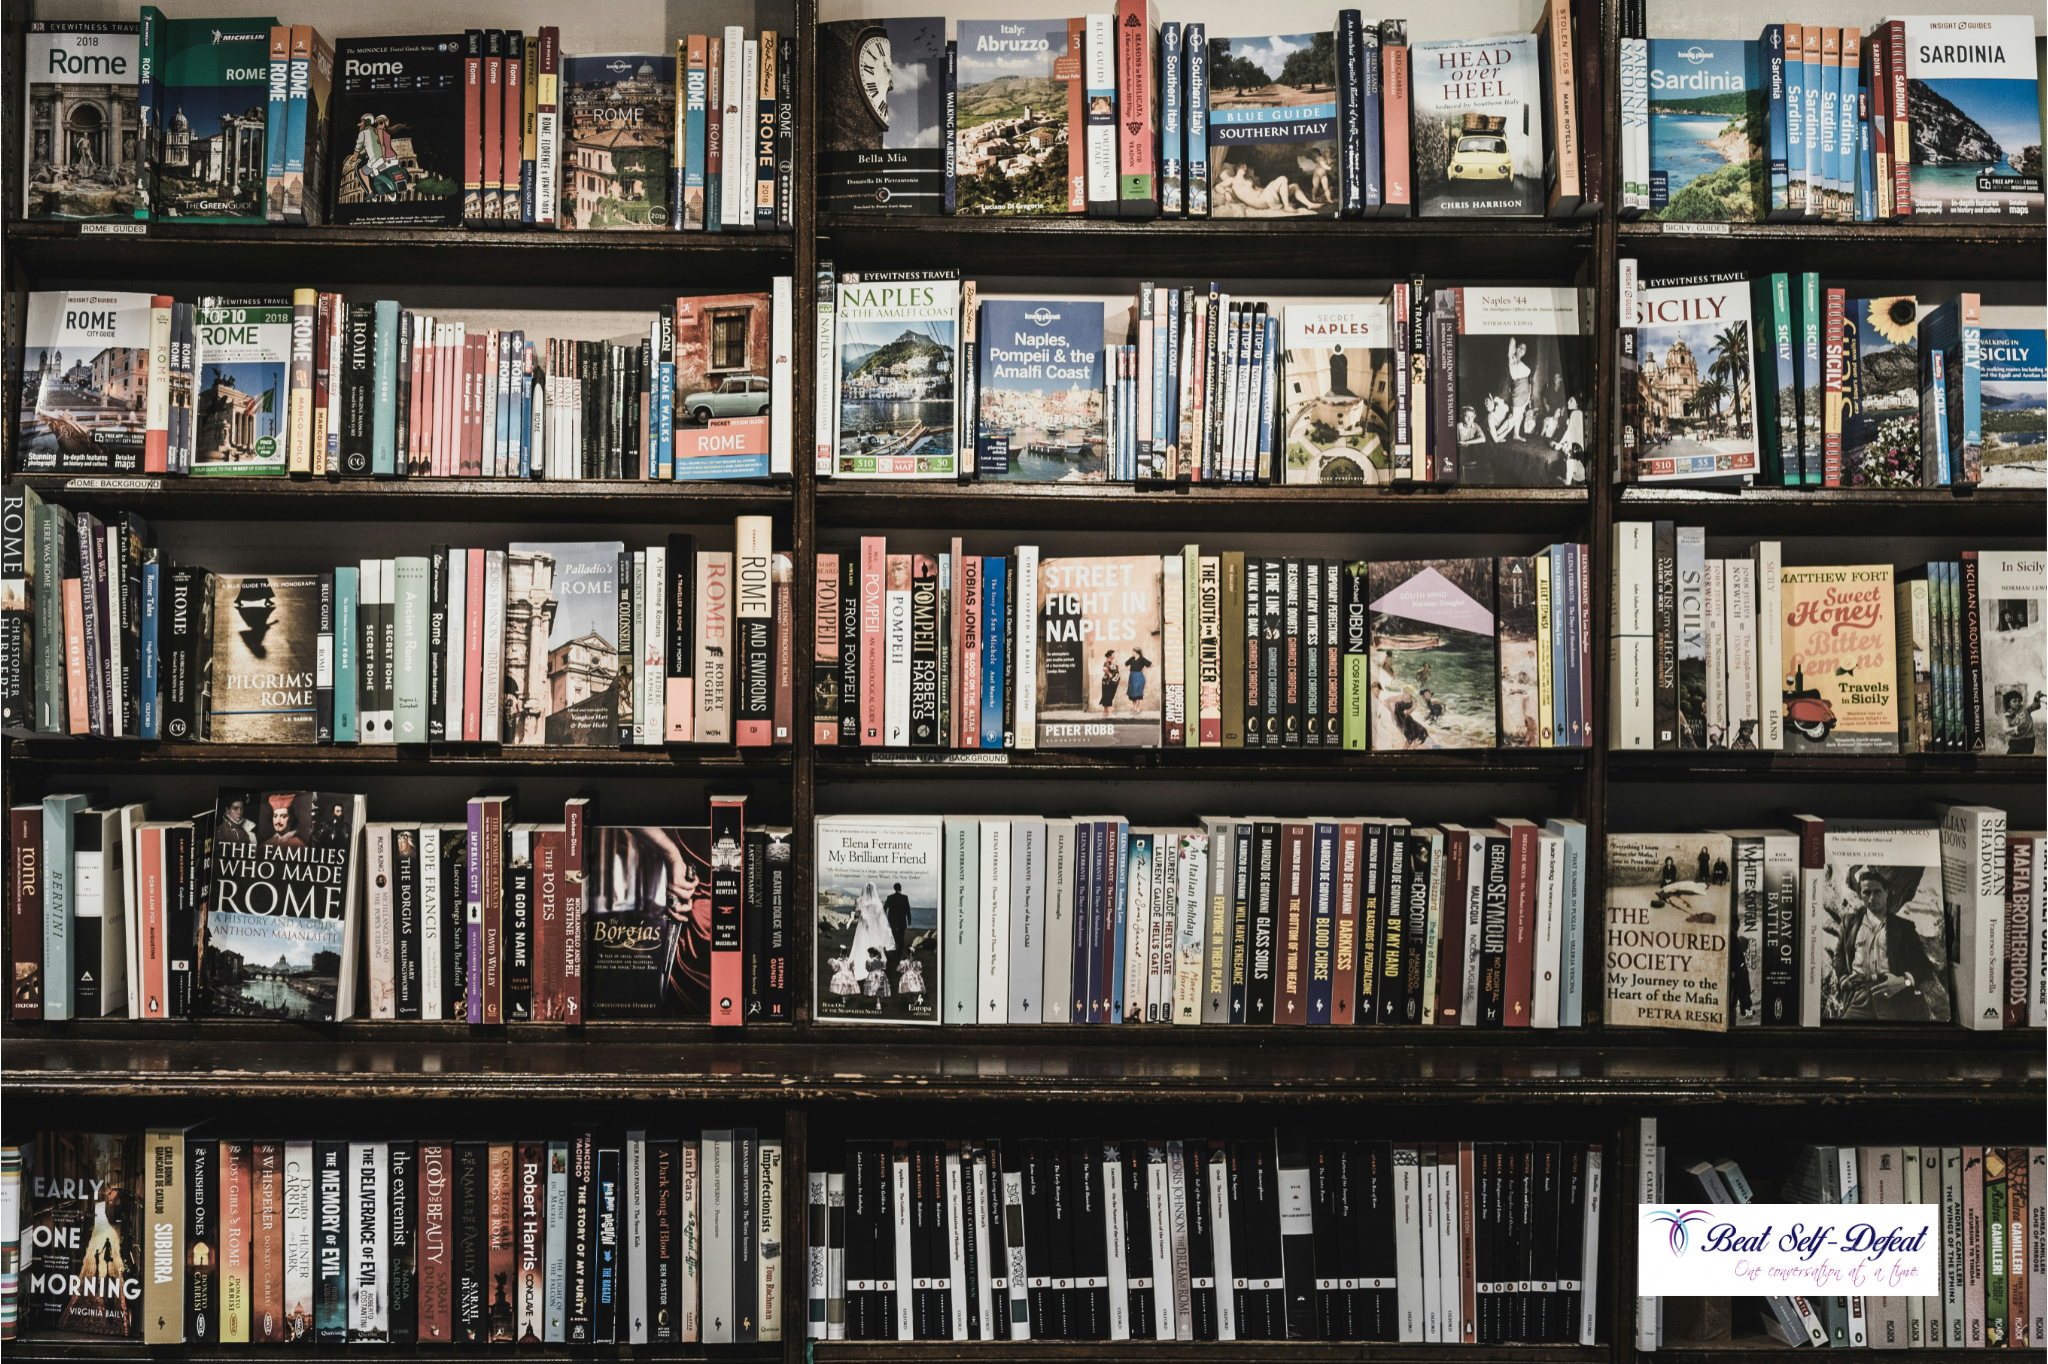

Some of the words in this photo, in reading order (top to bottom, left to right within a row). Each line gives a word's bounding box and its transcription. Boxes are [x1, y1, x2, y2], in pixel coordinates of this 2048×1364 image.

[50, 23, 108, 32] EYEWITNESS
[222, 32, 266, 41] MICHELIN
[1000, 25, 1025, 35] Italy:
[1930, 22, 1956, 30] INSIGHT
[76, 36, 99, 47] 2018
[977, 36, 1049, 52] Abruzzo
[49, 49, 127, 74] Rome
[1438, 49, 1512, 69] HEAD
[1919, 46, 2006, 64] SARDINIA
[142, 57, 150, 84] ROME
[226, 68, 266, 81] ROME
[345, 60, 403, 76] Rome
[1166, 55, 1177, 96] Southern
[1451, 67, 1501, 81] over
[1650, 69, 1744, 90] Sardinia
[270, 63, 287, 102] ROME
[1443, 82, 1511, 100] HEEL
[593, 108, 644, 122] ROME
[946, 92, 954, 129] WALKING
[1167, 100, 1176, 133] Italy
[1227, 112, 1264, 121] BLUE
[1272, 108, 1321, 119] GUIDE
[760, 113, 773, 167] ROME
[946, 131, 954, 139] IN
[1220, 127, 1289, 138] SOUTHERN
[1293, 123, 1327, 135] ITALY
[858, 154, 882, 163] Bella
[886, 154, 908, 163] Mia
[946, 142, 954, 178] ABRUZZO
[1441, 201, 1470, 209] CHRIS
[1473, 199, 1522, 208] HARRISON
[83, 225, 110, 233] ROME:
[112, 224, 144, 233] GUIDES
[1665, 224, 1693, 232] SICILY:
[864, 272, 920, 280] EYEWITNESS
[923, 270, 956, 279] TRAVEL
[843, 287, 934, 308] NAPLES
[1481, 295, 1510, 305] Naples
[66, 311, 116, 330] ROME
[851, 308, 872, 316] THE
[875, 308, 914, 317] AMALFI
[917, 307, 955, 316] COAST
[1317, 314, 1354, 322] SECRET
[201, 327, 258, 345] ROME
[662, 317, 670, 352] MOON
[1304, 323, 1369, 335] NAPLES
[1415, 306, 1423, 349] TRAVELER
[353, 321, 366, 370] ROME
[1015, 332, 1070, 348] Naples,
[1779, 324, 1790, 360] SICILY
[1964, 329, 1979, 369] SICILY
[990, 348, 1051, 364] Pompeii
[1054, 349, 1066, 362] &
[1070, 348, 1095, 362] the
[1980, 348, 2029, 361] SICILY
[994, 365, 1041, 379] Amalfi
[1045, 364, 1090, 379] Coast
[661, 405, 669, 442] WALKS
[698, 434, 745, 451] ROME
[100, 480, 159, 488] BACKGROUND
[3, 496, 24, 573] ROME
[1045, 564, 1133, 588] STREET
[1851, 571, 1889, 583] FORT
[2002, 562, 2012, 571] In
[2014, 561, 2045, 574] Sicily
[560, 581, 613, 594] ROME
[741, 556, 766, 612] ROME
[1965, 563, 1977, 608] SICILIAN
[705, 562, 726, 640] ROME
[1046, 593, 1115, 617] FIGHT
[1123, 591, 1145, 613] IN
[1683, 570, 1701, 648] SICILY
[844, 598, 856, 639] FROM
[1349, 604, 1363, 652] DIBDIN
[751, 623, 765, 647] AND
[1046, 619, 1136, 642] NAPLES
[1968, 611, 1979, 665] CAROUSEL
[366, 624, 374, 661] SECRET
[11, 618, 20, 697] CHRISTOPHER
[227, 672, 312, 689] PILGRIM'S
[750, 651, 766, 712] ENVIRONS
[843, 645, 856, 704] POMPEII
[261, 691, 312, 706] ROME
[1839, 683, 1889, 693] Travels
[1851, 693, 1889, 706] Sicily
[1046, 725, 1080, 736] PETER
[1083, 724, 1114, 735] ROBB
[873, 753, 915, 761] SOUTHERN
[949, 754, 1007, 762] BACKGROUND
[219, 842, 256, 858] THE
[264, 845, 345, 865] FAMILIES
[425, 834, 435, 871] POPE
[841, 838, 868, 850] Elena
[872, 839, 912, 850] Ferrante
[828, 850, 846, 865] My
[849, 850, 889, 864] Brilliant
[891, 851, 926, 864] Friend
[23, 848, 35, 896] rome
[219, 859, 276, 879] WHO
[282, 863, 341, 884] MADE
[515, 876, 525, 889] IN
[52, 871, 62, 939] BERNINI
[217, 879, 341, 920] ROME
[425, 875, 436, 939] FRANCIS
[1485, 884, 1506, 953] SEYMOUR
[1608, 908, 1650, 925] THE
[213, 927, 268, 937] ANTHONY
[271, 929, 337, 942] MAJANLAHTI
[594, 922, 661, 940] Borgias
[1316, 918, 1331, 948] BLOOD
[1608, 929, 1725, 952] HONOURED
[515, 932, 525, 968] NAME
[1337, 919, 1353, 970] DARKNESS
[2010, 893, 2028, 1005] BROTHERHOODS
[1314, 950, 1328, 981] CURSE
[1608, 953, 1692, 972] SOCIETY
[1638, 1008, 1681, 1021] PETRA
[1685, 1010, 1723, 1024] RESKI
[1173, 1157, 1183, 1184] BORIS
[35, 1177, 104, 1199] EARLY
[262, 1156, 274, 1231] WHISPERER
[523, 1163, 537, 1213] Robert
[762, 1149, 774, 1233] Imperfectionists
[321, 1170, 337, 1231] MEMORY
[360, 1168, 376, 1244] DELIVERANCE
[392, 1173, 409, 1246] extremist
[1175, 1187, 1185, 1234] JOHNSON
[32, 1225, 80, 1248] ONE
[523, 1217, 536, 1270] Harris
[154, 1224, 173, 1285] SUBURRA
[1992, 1223, 2003, 1275] CAMILLERI
[322, 1248, 339, 1280] EVIL
[30, 1274, 141, 1300] MORNING
[525, 1274, 534, 1317] CONCLAVE
